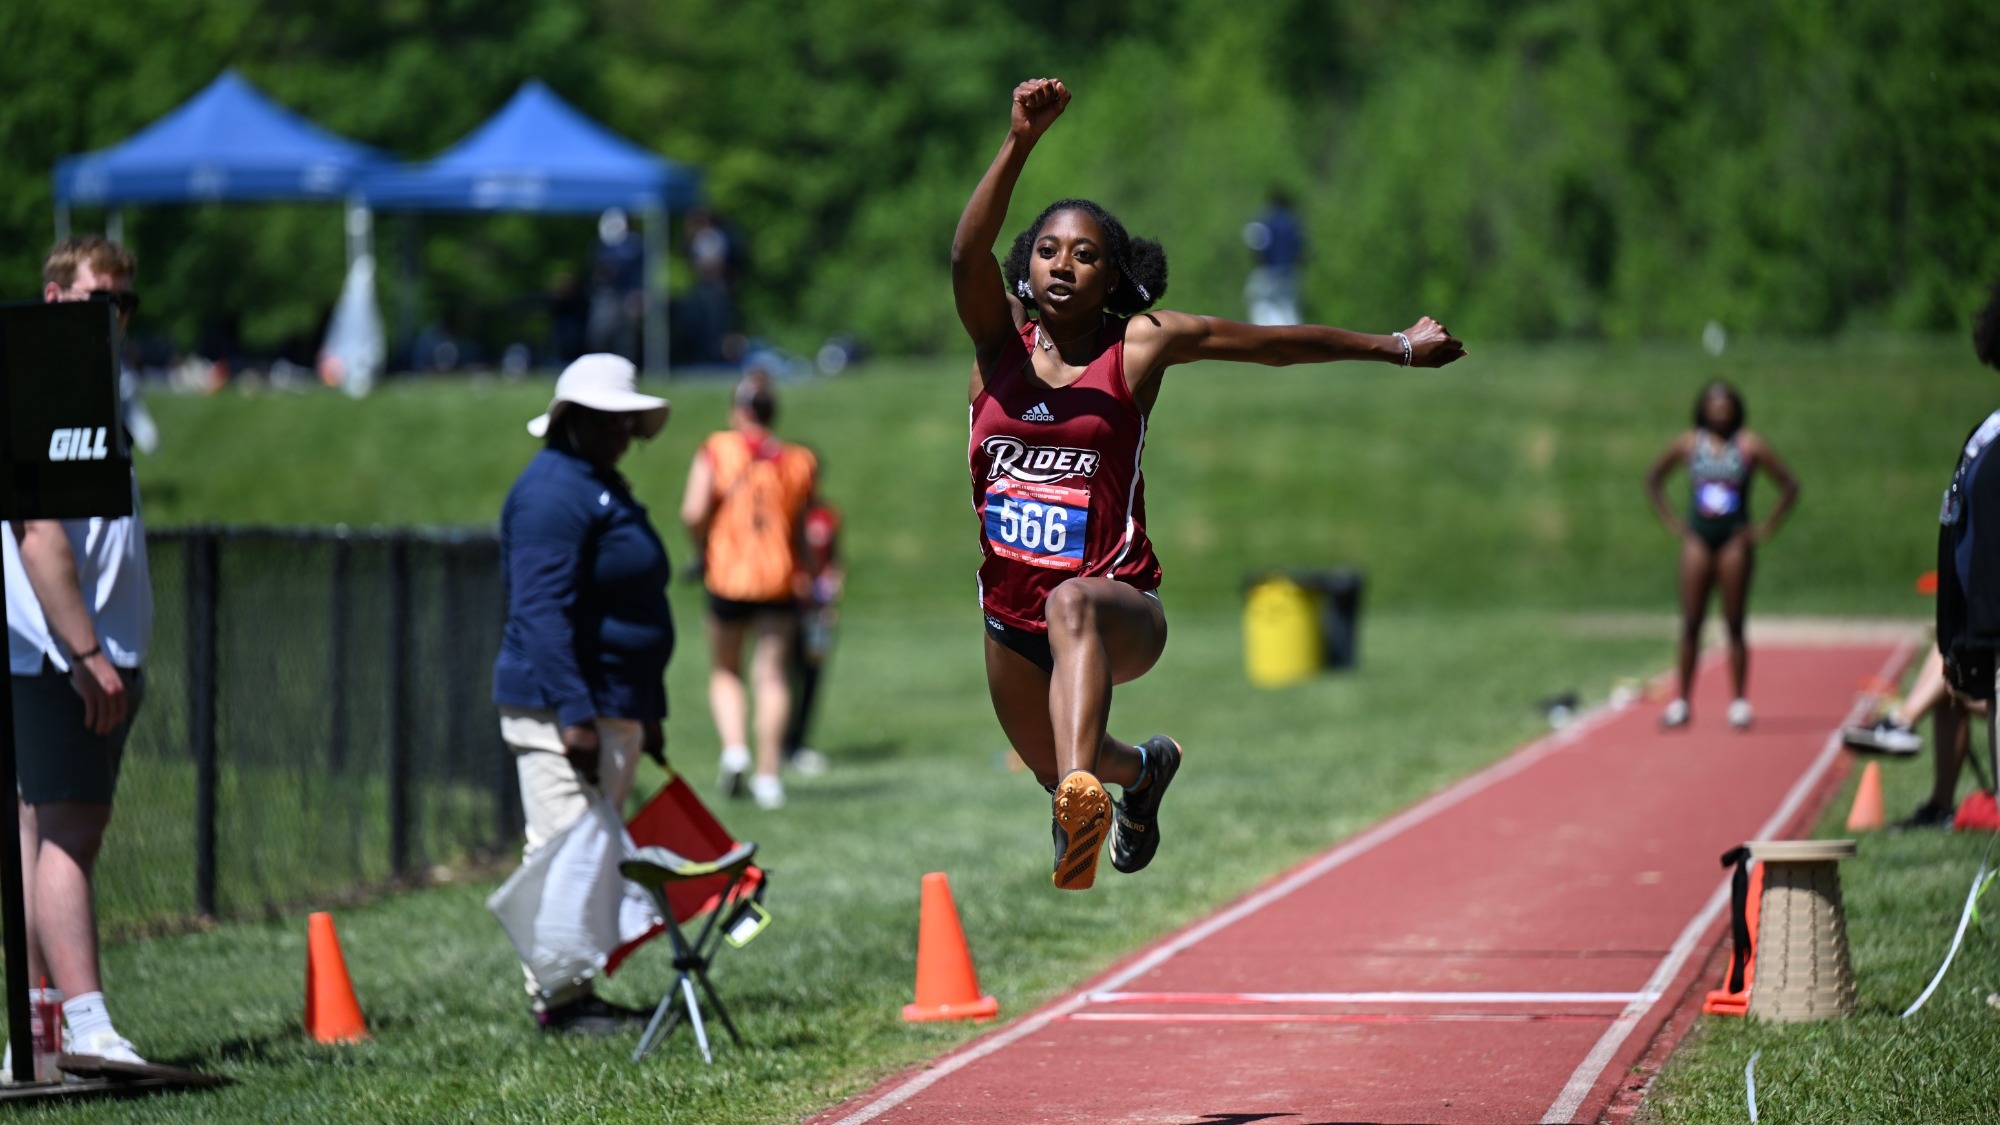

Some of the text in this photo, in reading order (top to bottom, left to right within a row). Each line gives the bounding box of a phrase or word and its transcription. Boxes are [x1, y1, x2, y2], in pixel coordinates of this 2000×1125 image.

[1022, 413, 1054, 421] adidas
[48, 426, 108, 462] GILL
[1001, 499, 1067, 552] 566
